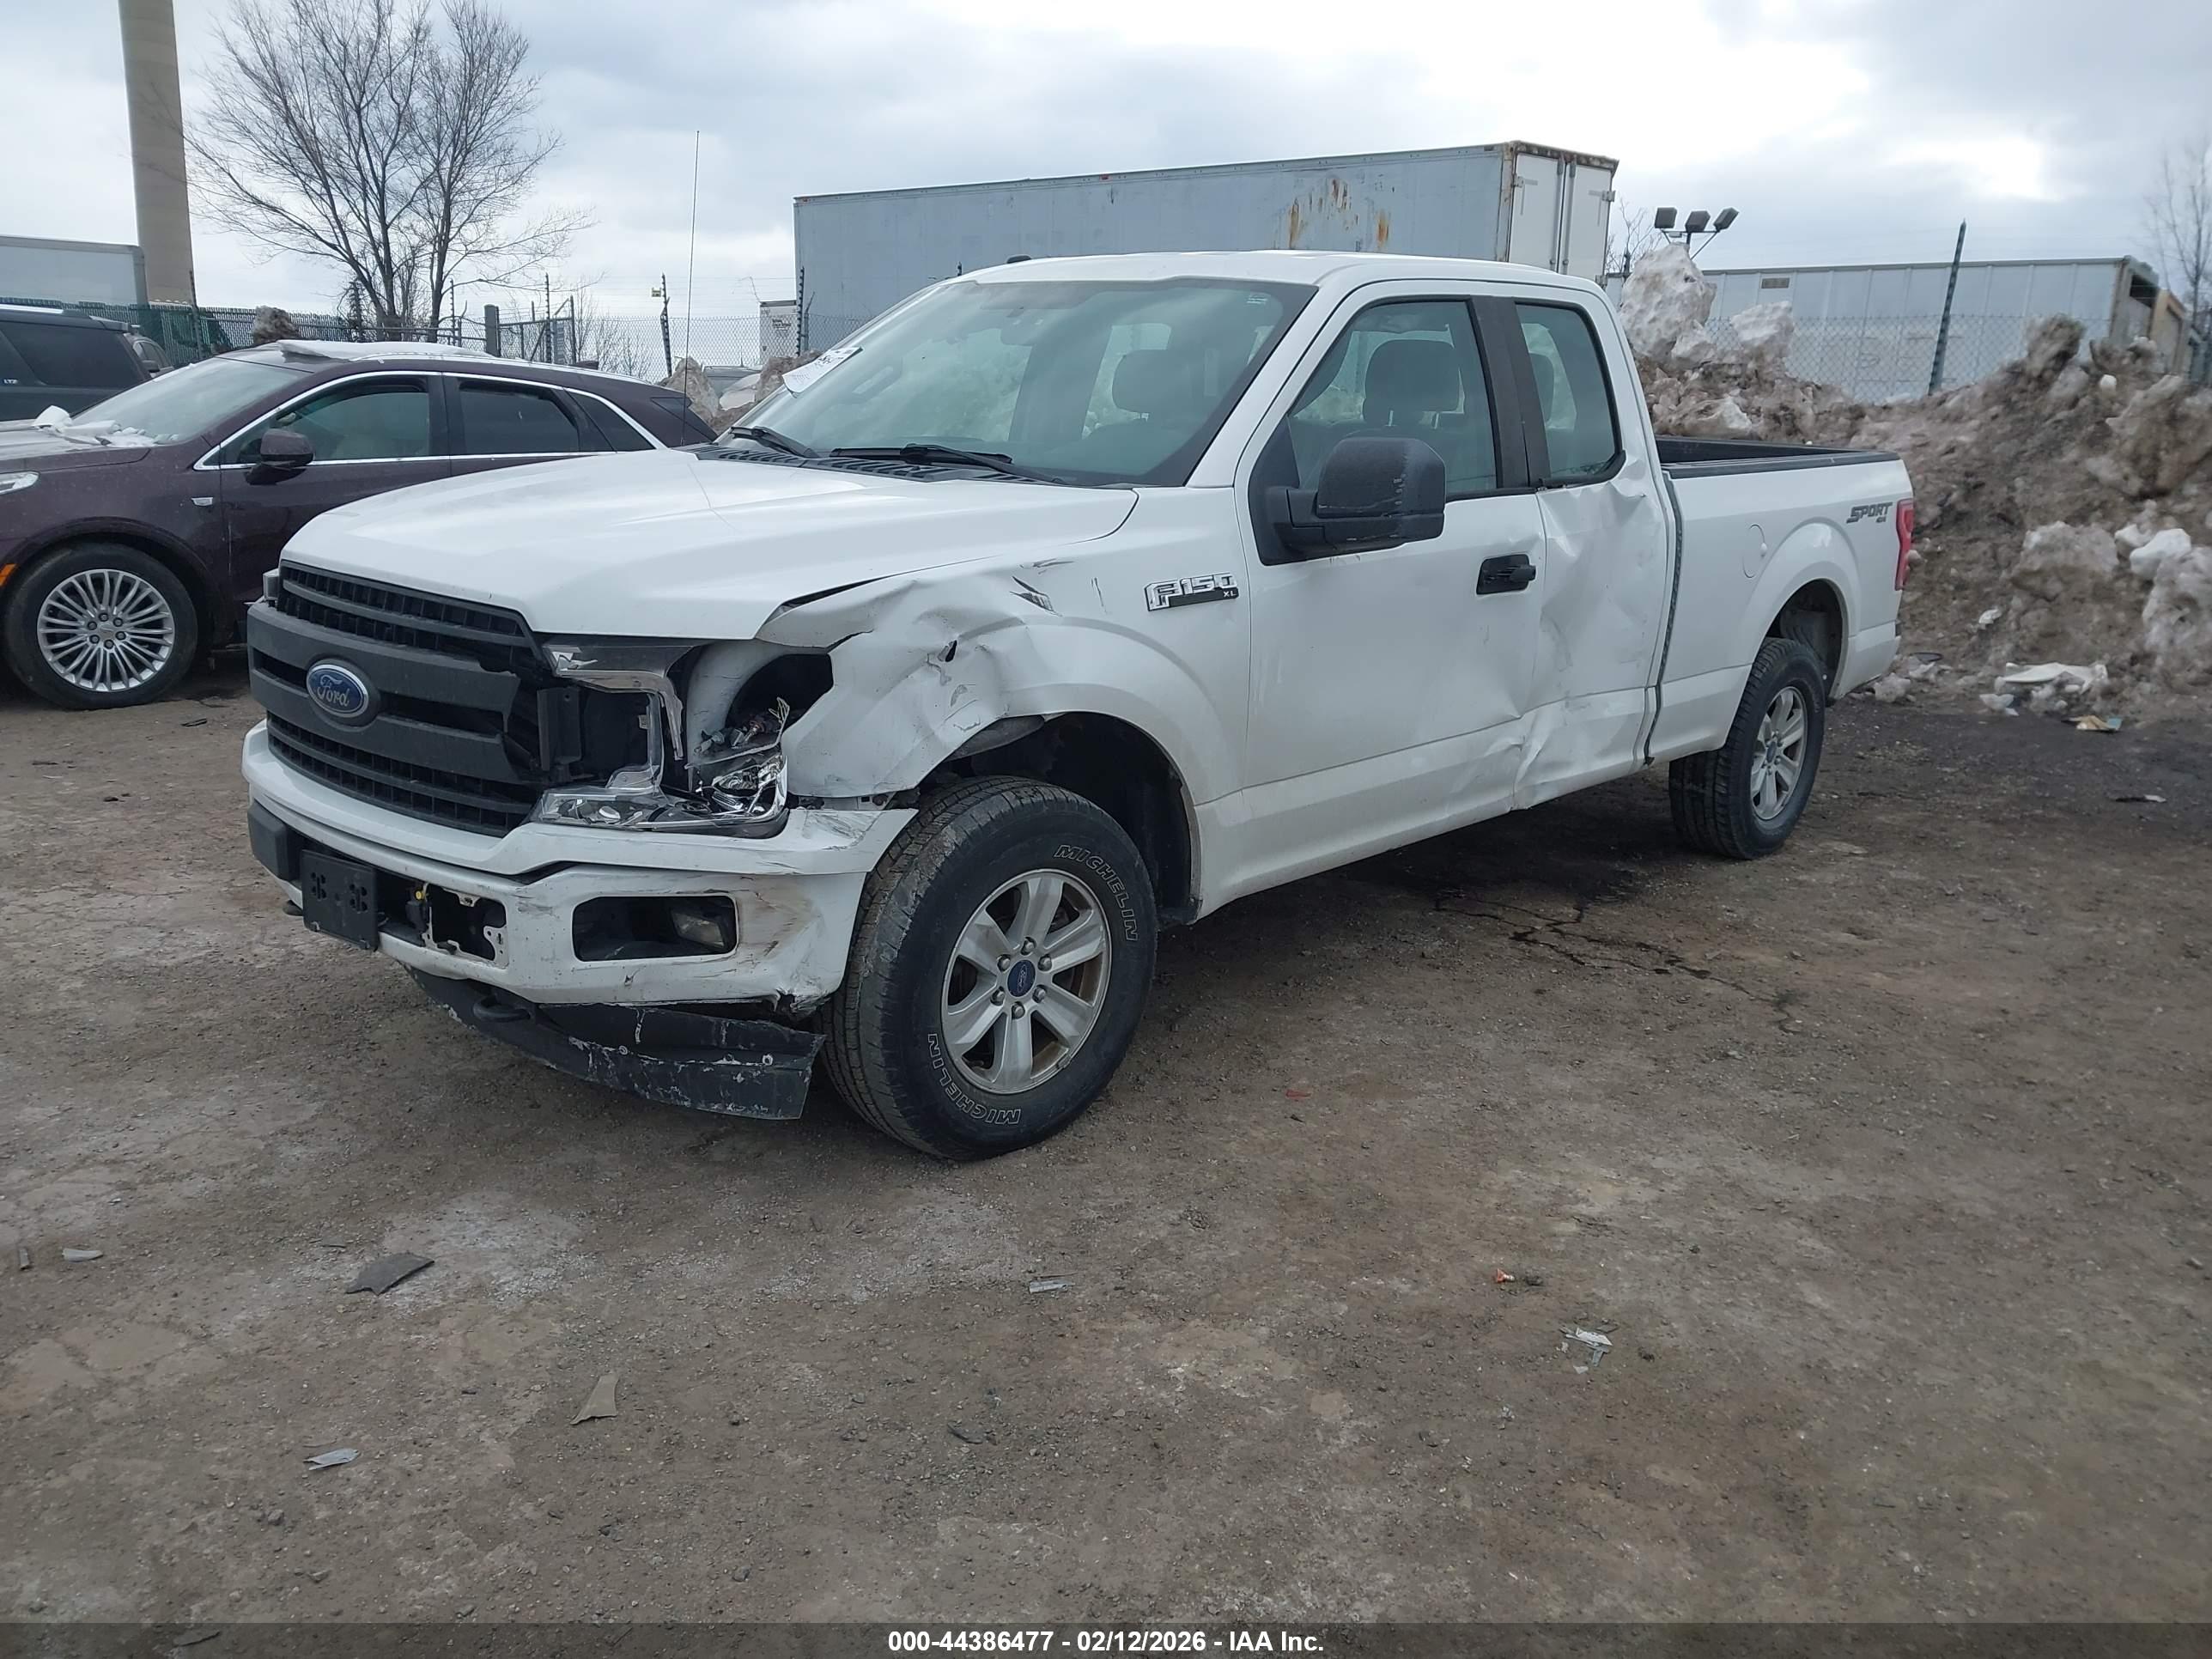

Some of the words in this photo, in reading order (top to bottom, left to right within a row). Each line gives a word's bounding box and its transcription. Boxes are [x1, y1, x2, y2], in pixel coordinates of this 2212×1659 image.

[1846, 501, 1893, 524] SPORT
[317, 674, 349, 707] Ford
[1053, 844, 1139, 942] MICHELIN
[927, 1033, 1021, 1126] MICHELIN
